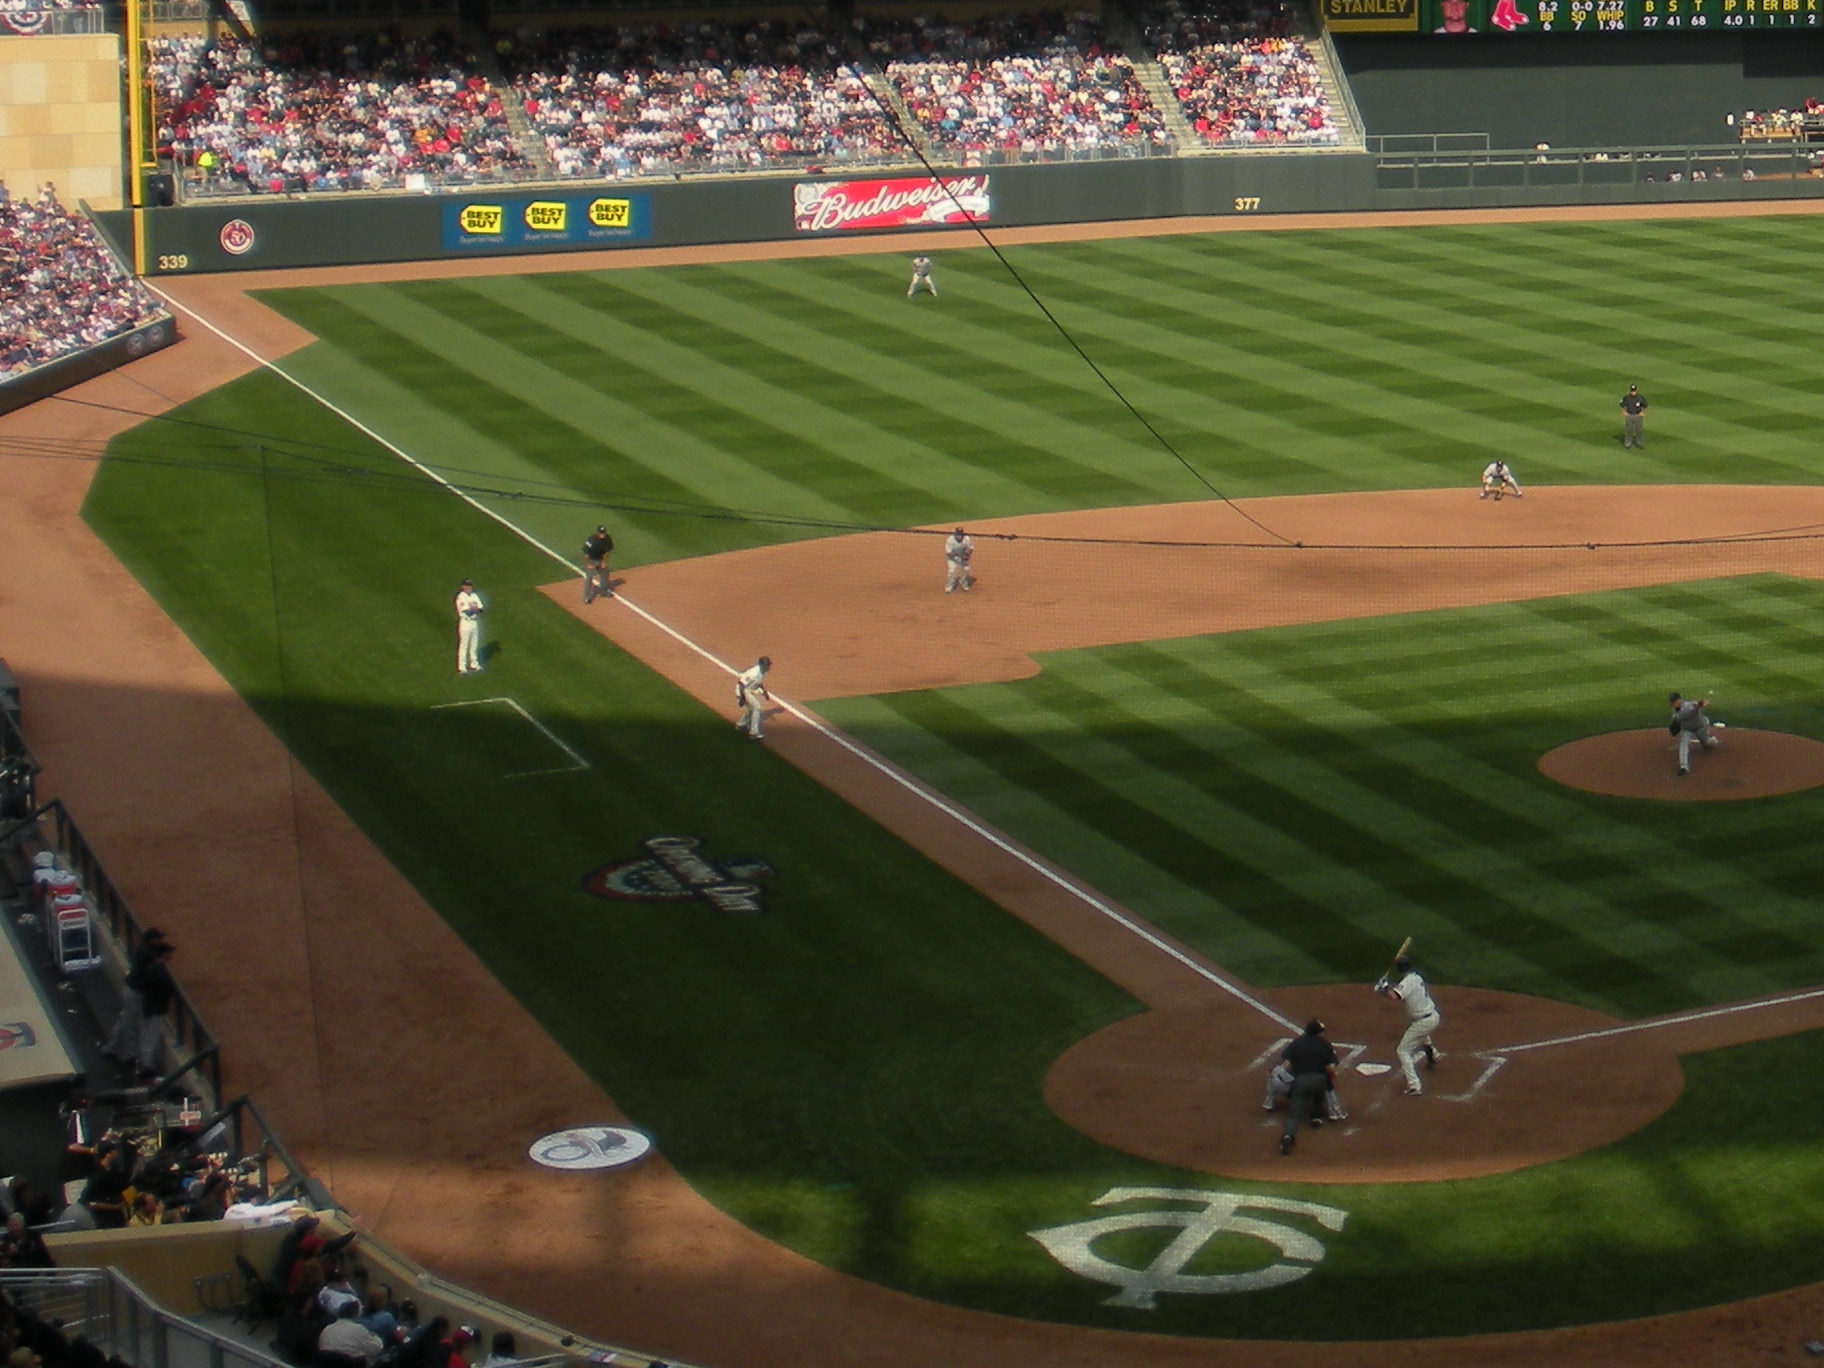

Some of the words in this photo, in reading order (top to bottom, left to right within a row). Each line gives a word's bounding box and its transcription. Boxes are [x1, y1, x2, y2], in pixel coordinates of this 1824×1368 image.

[803, 175, 976, 230] Budweiser
[1235, 197, 1260, 210] 377
[531, 208, 563, 216] BEST
[595, 205, 627, 213] BEST
[467, 211, 500, 220] BEST
[597, 213, 623, 221] BUY
[468, 220, 496, 228] BUY
[533, 216, 560, 224] BUY
[159, 254, 188, 269] 339
